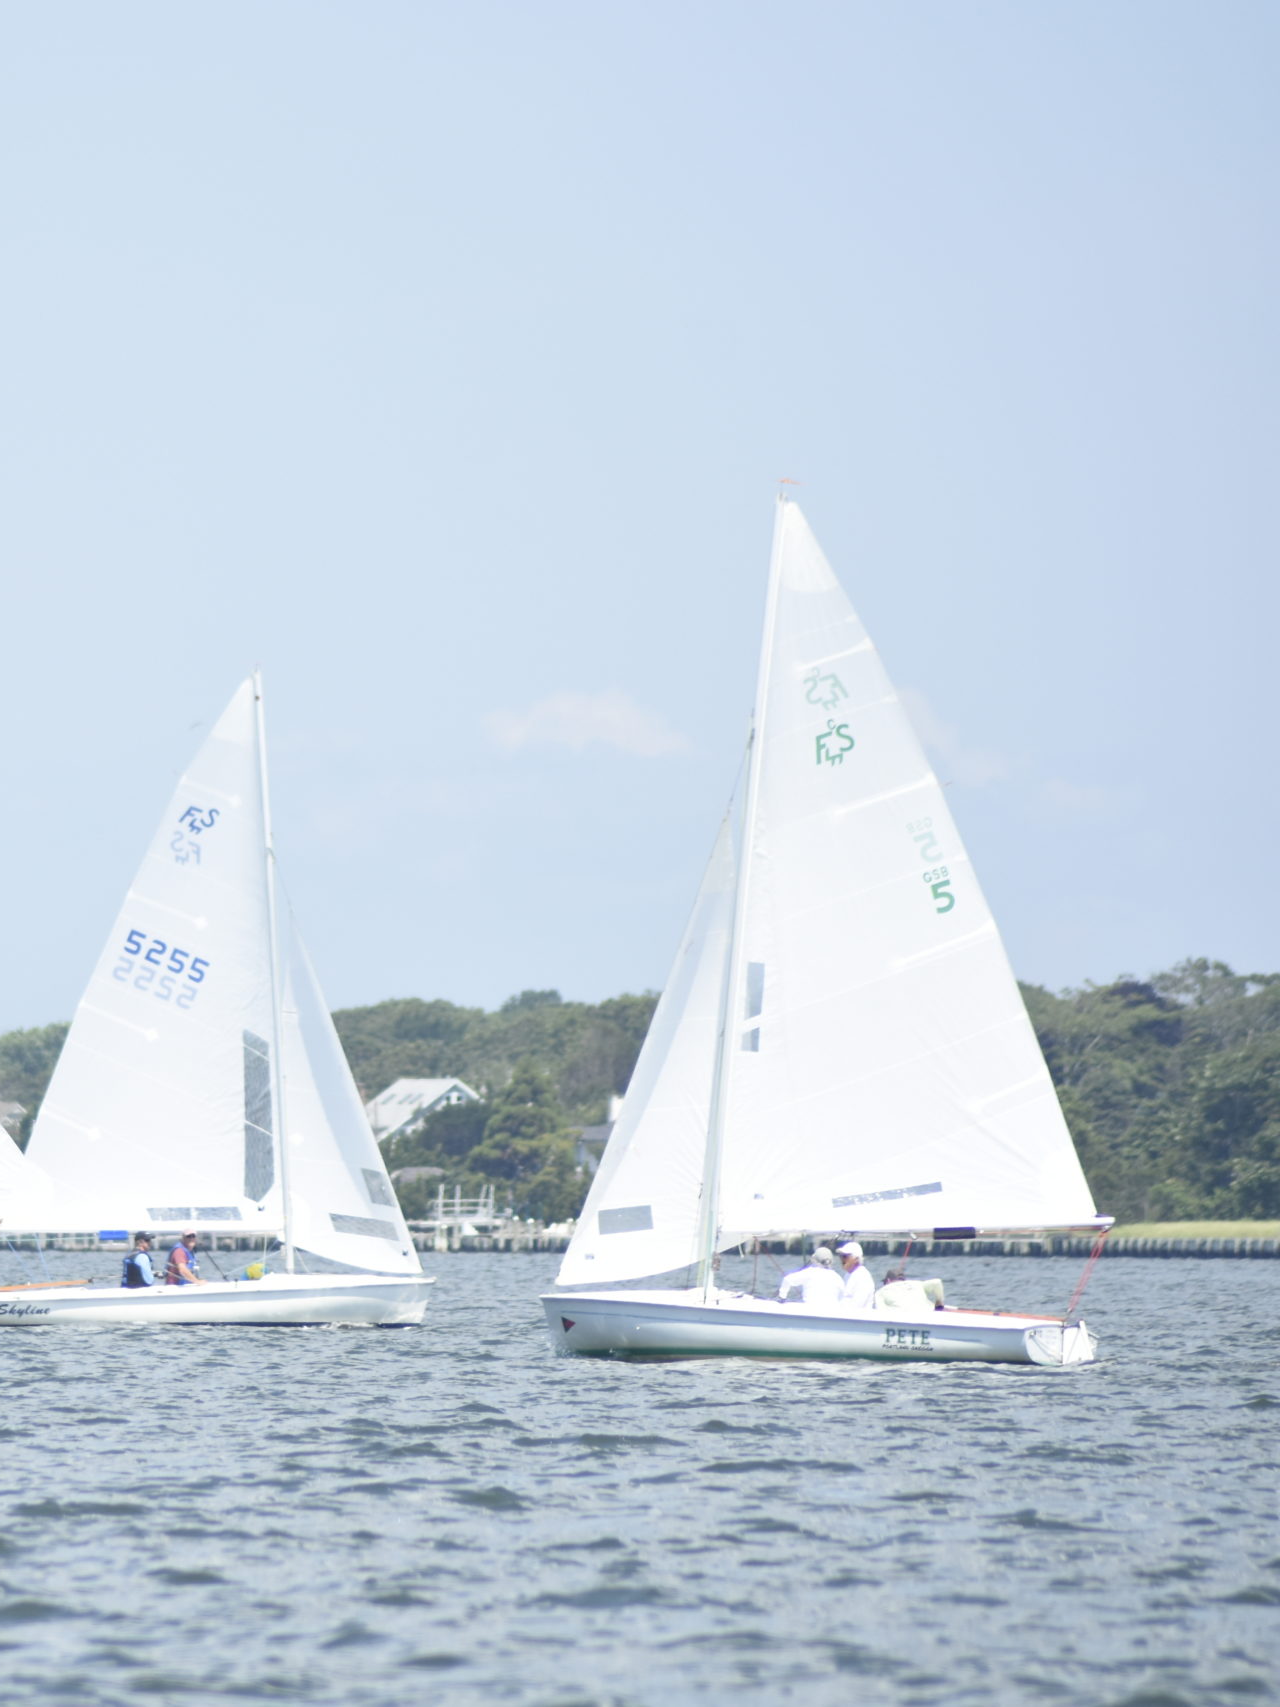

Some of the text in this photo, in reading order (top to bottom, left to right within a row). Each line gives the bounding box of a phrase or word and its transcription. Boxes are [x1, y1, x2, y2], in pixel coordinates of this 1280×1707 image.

[930, 879, 956, 914] 5
[124, 929, 210, 983] 5255
[885, 1328, 931, 1345] PETE
